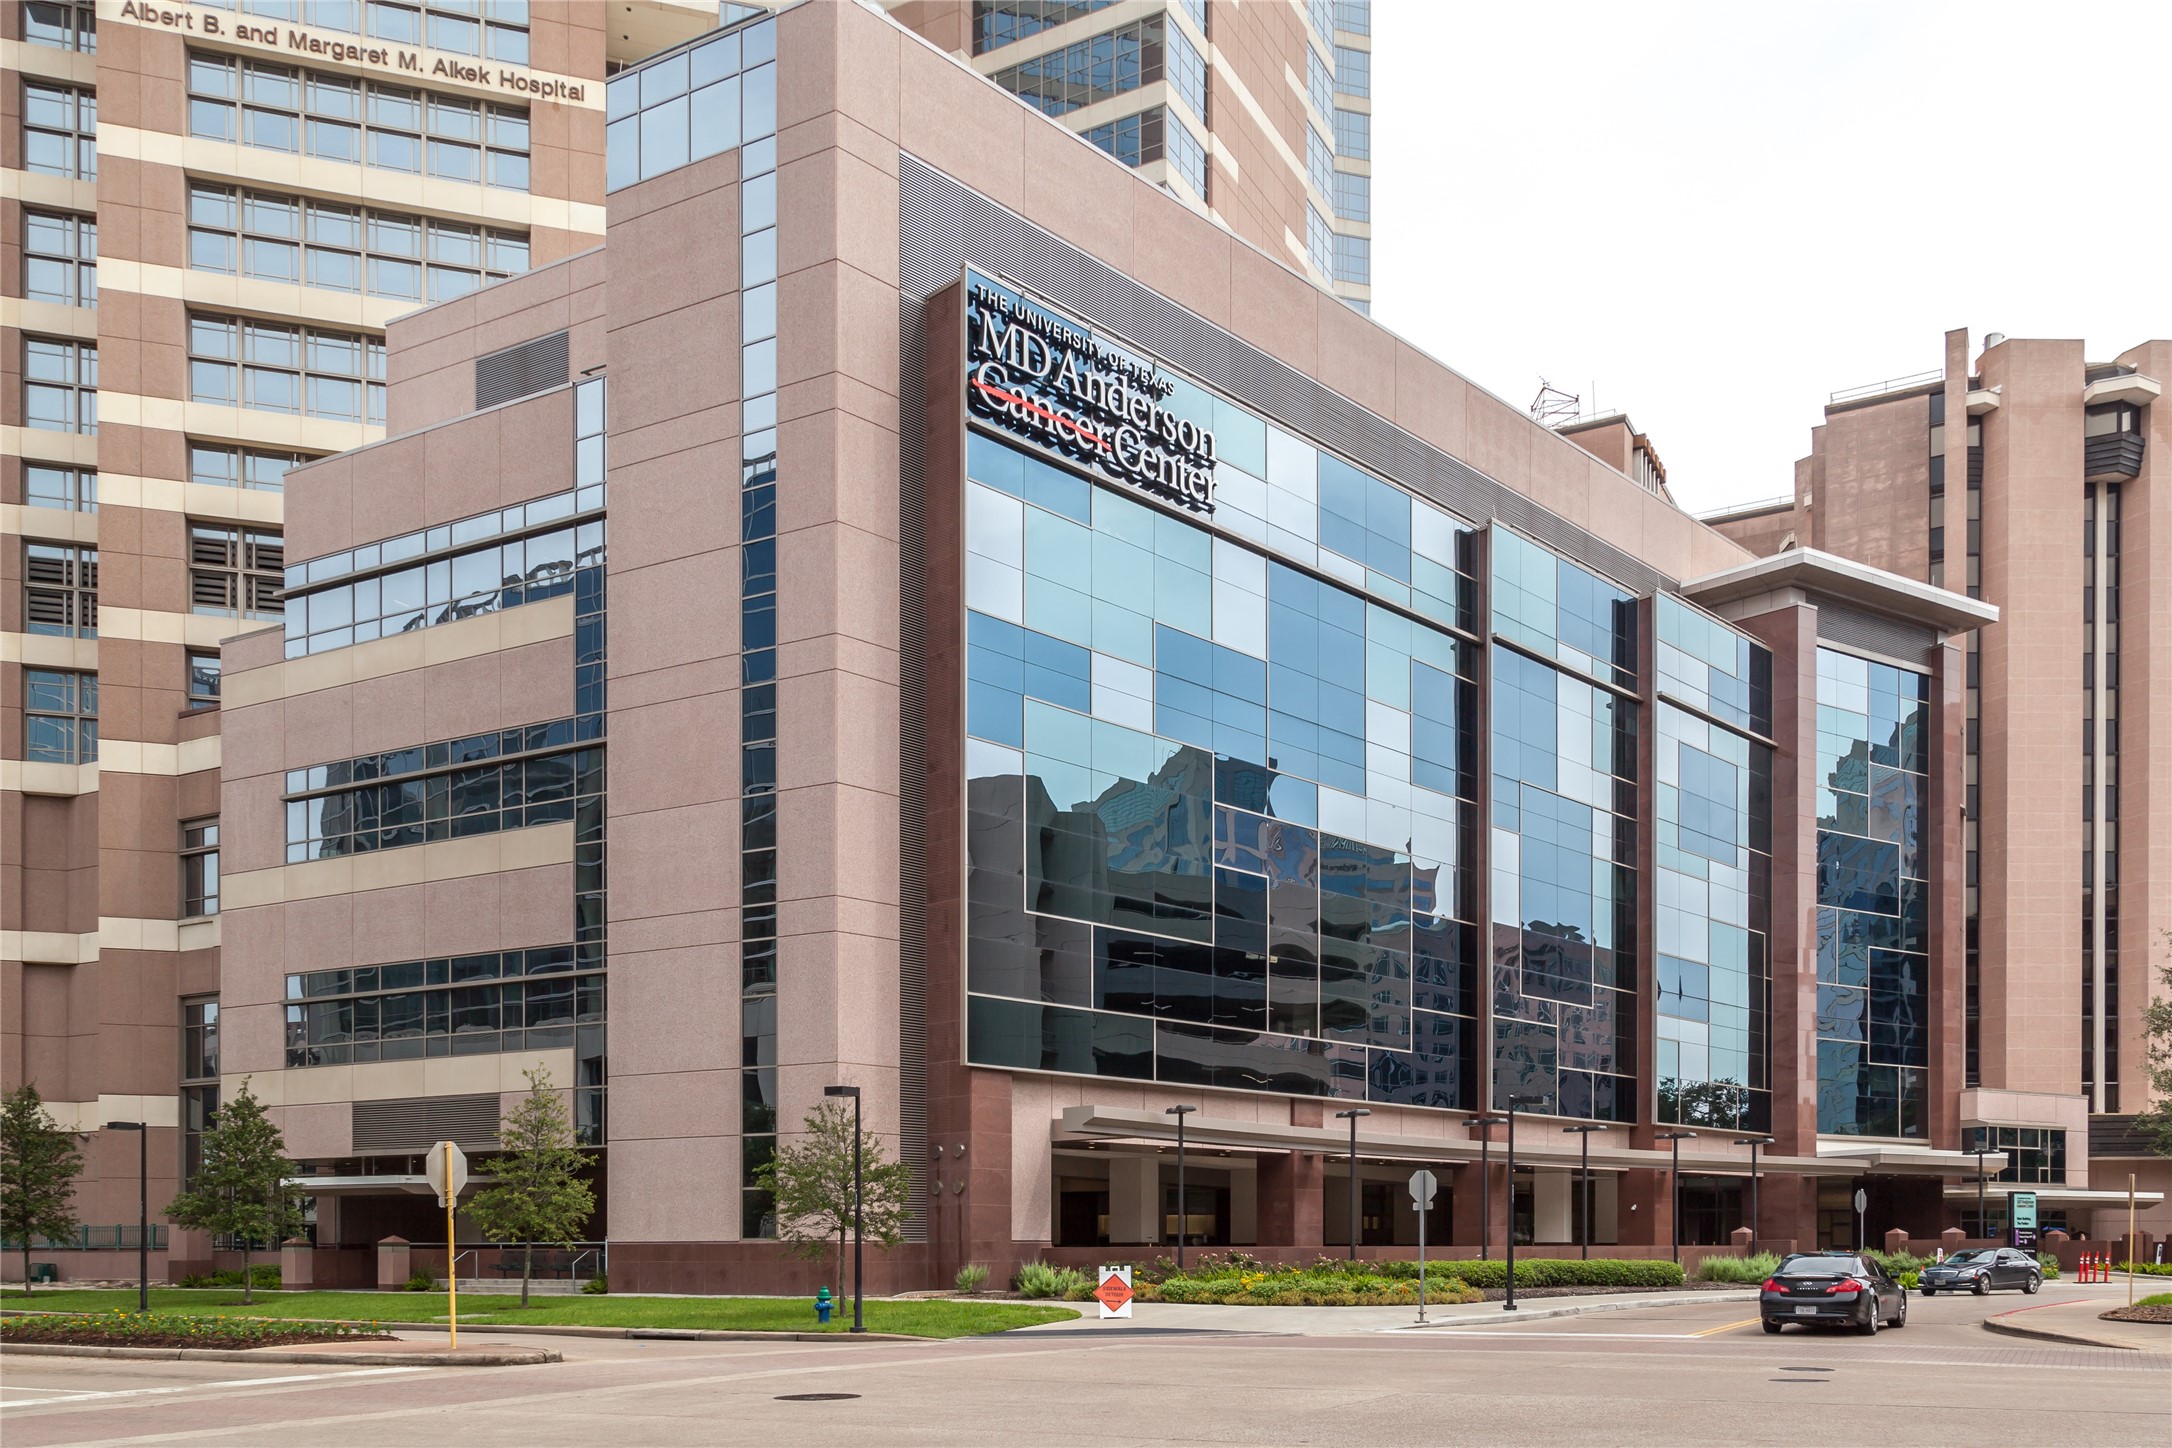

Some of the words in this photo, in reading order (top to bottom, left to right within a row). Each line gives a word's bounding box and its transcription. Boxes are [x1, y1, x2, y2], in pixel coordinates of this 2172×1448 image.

[121, 0, 194, 30] Albert
[204, 14, 226, 36] B.
[236, 24, 278, 46] and
[289, 30, 389, 66] Margaret
[398, 50, 424, 73] M.
[432, 57, 491, 85] Alkek
[499, 69, 585, 102] Hospital
[977, 283, 1009, 312] THE
[1015, 302, 1104, 355] UNIVERSITY
[1108, 351, 1127, 370] OF
[1131, 361, 1176, 396] TEXAS
[978, 307, 1052, 377] MD
[1053, 348, 1218, 463] Anderson
[976, 361, 1111, 455] Cancer
[1114, 425, 1220, 505] Center
